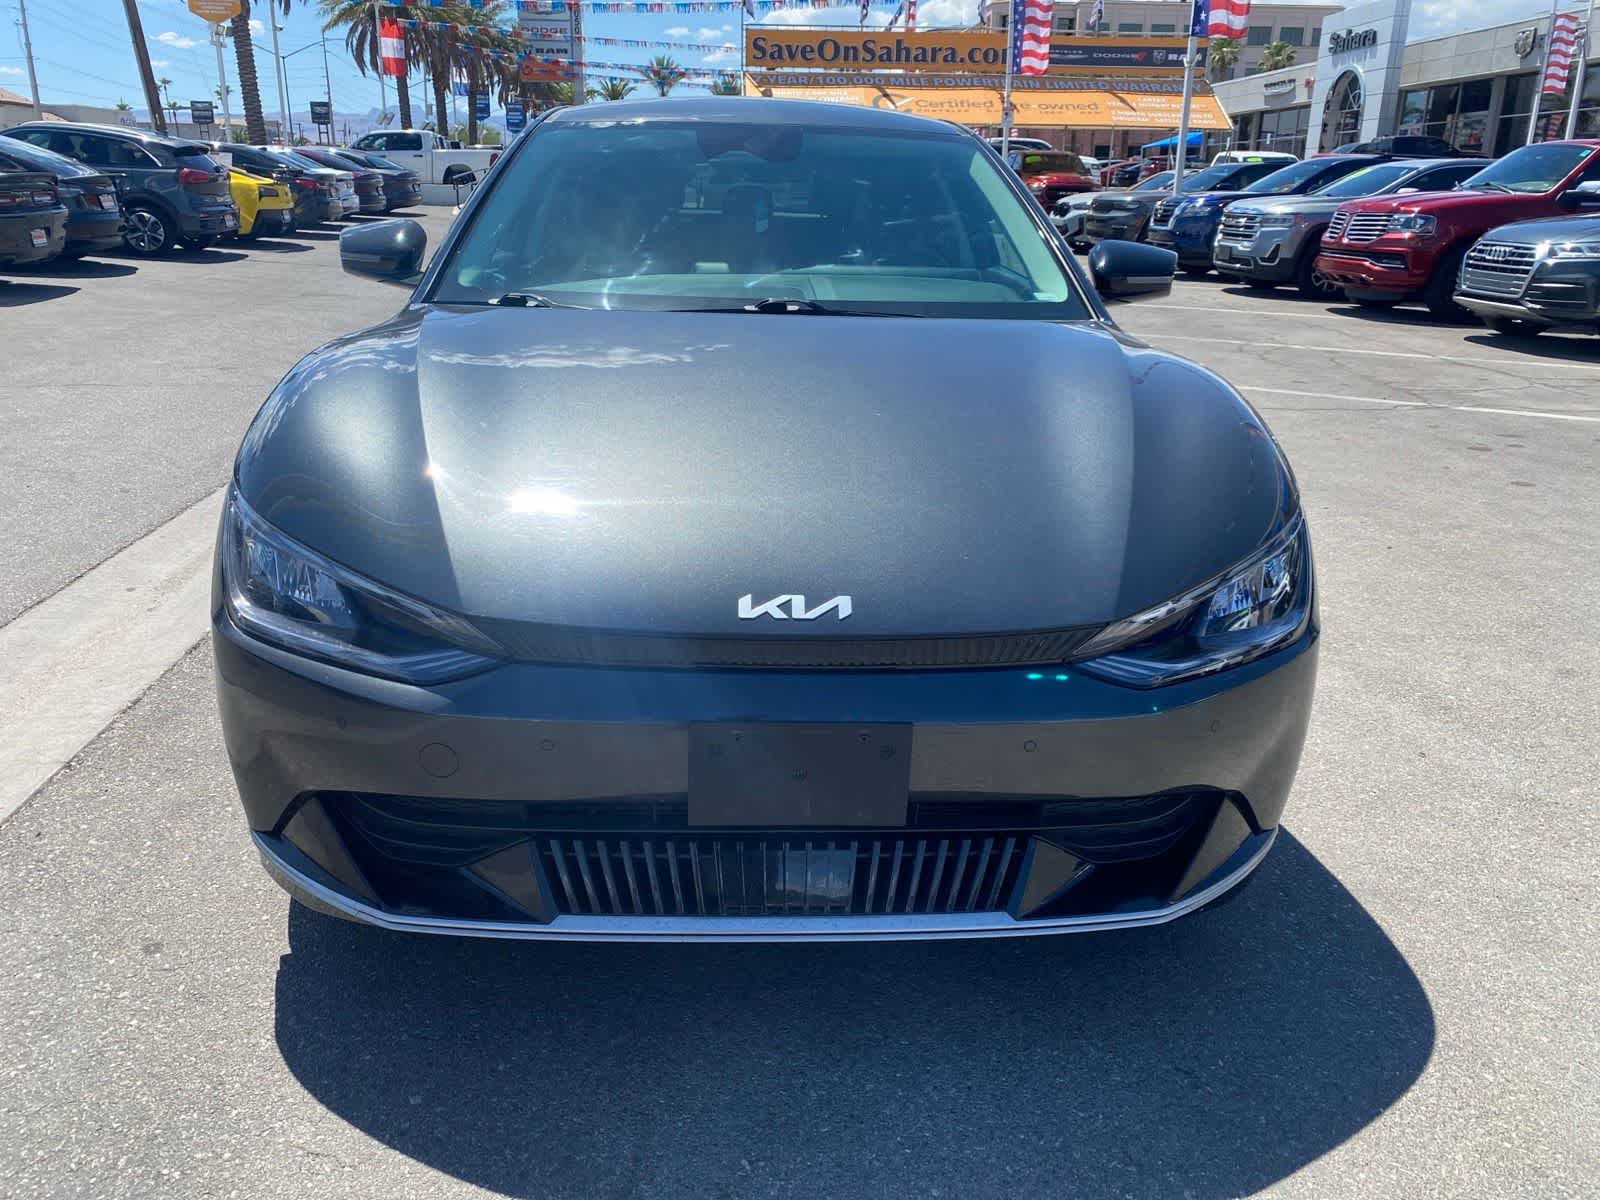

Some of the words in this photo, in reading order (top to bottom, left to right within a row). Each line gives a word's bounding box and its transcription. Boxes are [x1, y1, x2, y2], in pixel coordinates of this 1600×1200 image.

[1328, 28, 1377, 54] Sahara
[890, 78, 928, 87] MILE
[1044, 80, 1109, 90] LIMITED
[914, 98, 994, 109] Certified
[737, 593, 853, 620] KIA
